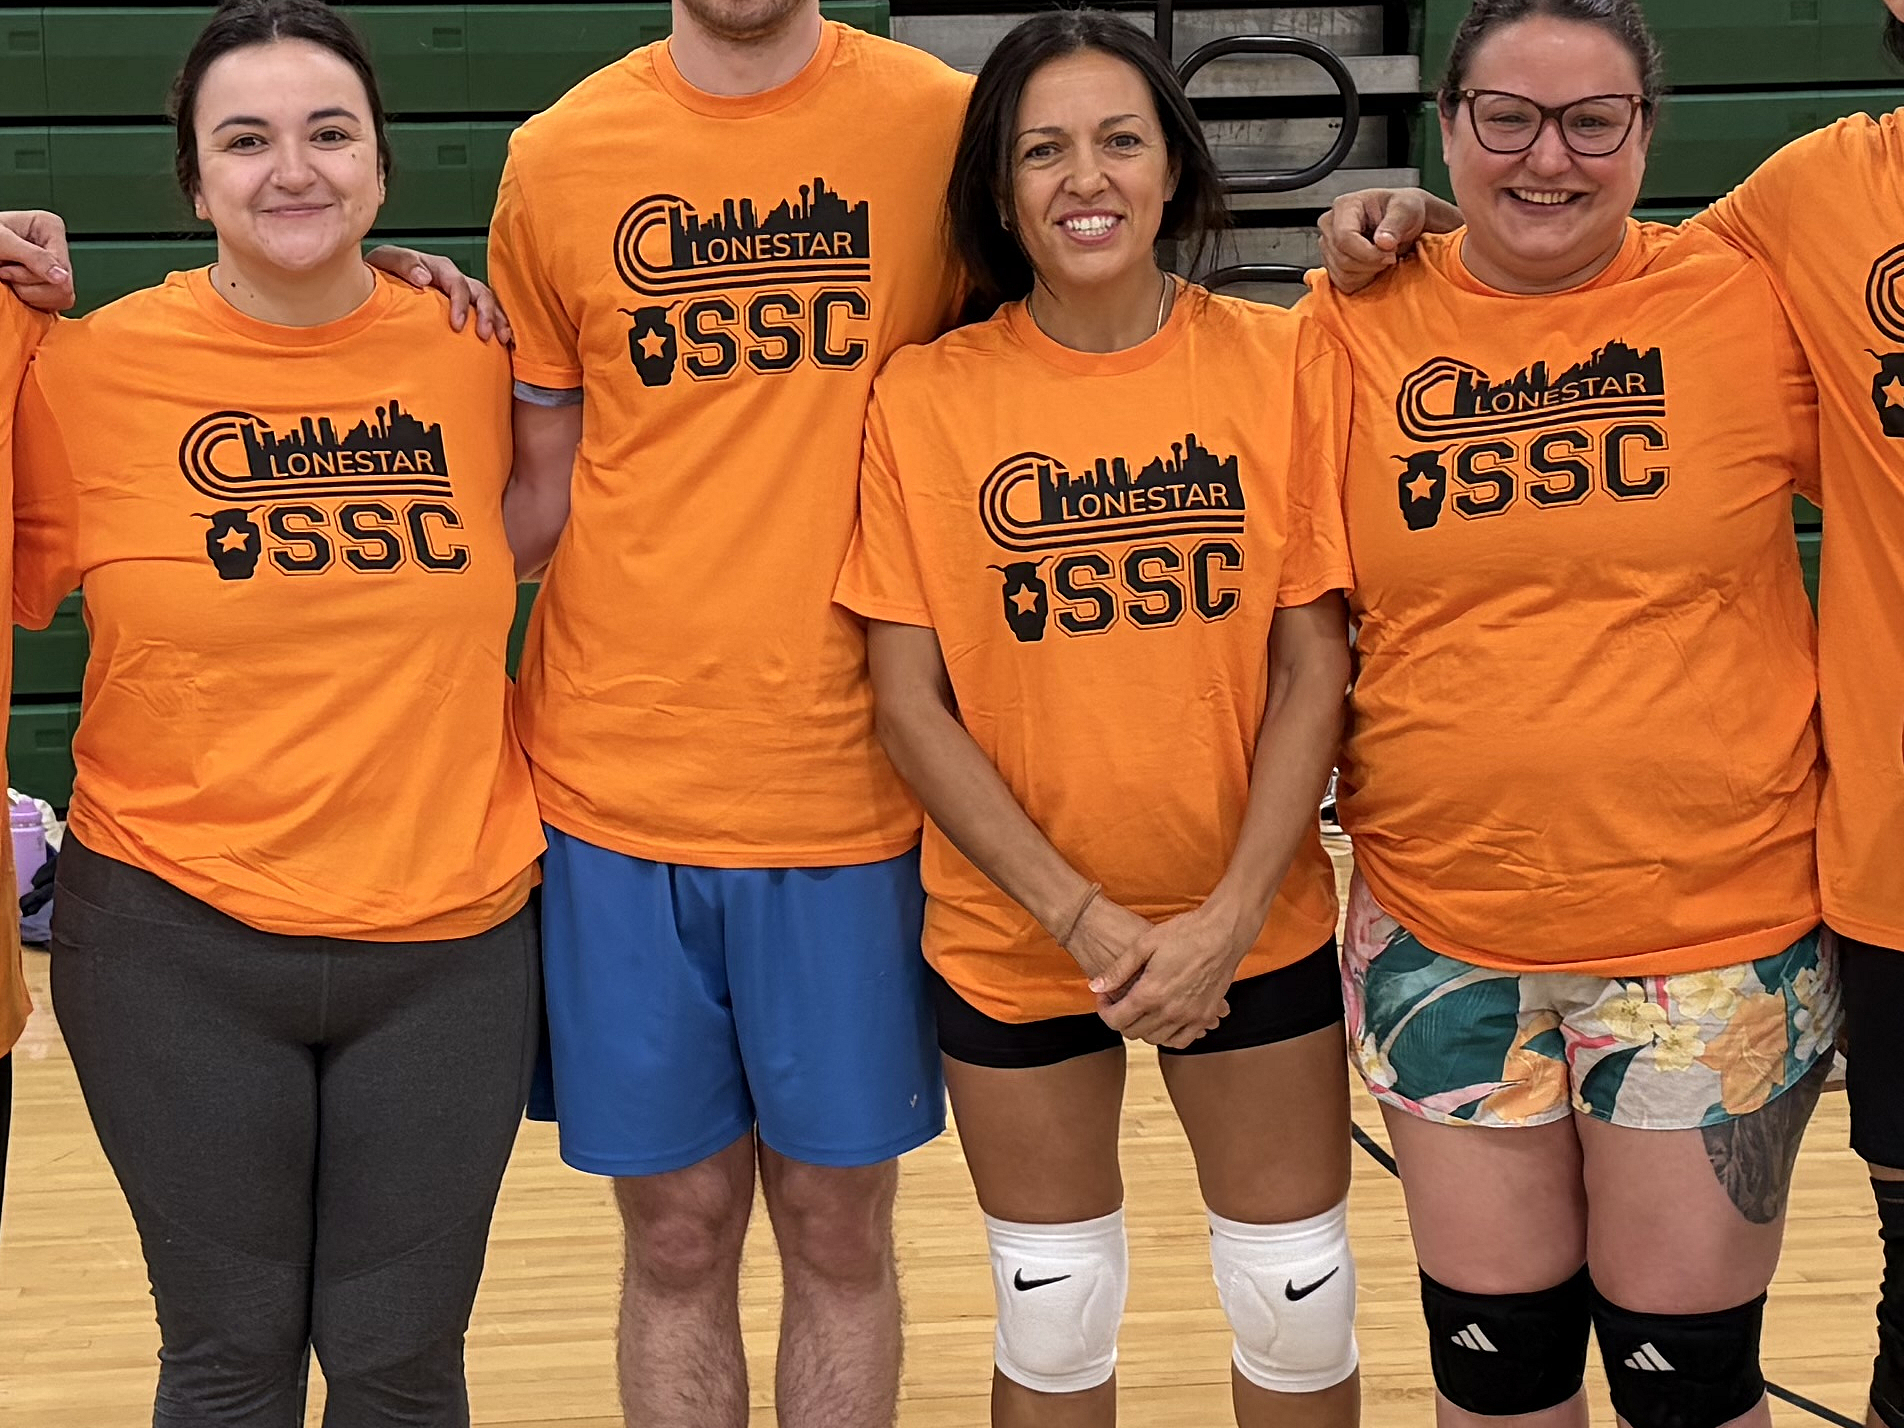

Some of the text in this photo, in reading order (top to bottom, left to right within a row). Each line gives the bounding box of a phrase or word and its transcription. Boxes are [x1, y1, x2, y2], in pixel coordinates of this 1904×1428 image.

[692, 231, 853, 265] LONESTAR
[681, 287, 869, 381] SSC
[1474, 373, 1646, 414] LONESTAR
[269, 449, 434, 478] LONESTAR
[1451, 422, 1670, 519] SSC
[1060, 482, 1229, 520] LONESTAR
[262, 501, 471, 575] SSC
[1052, 539, 1243, 637] SSC
